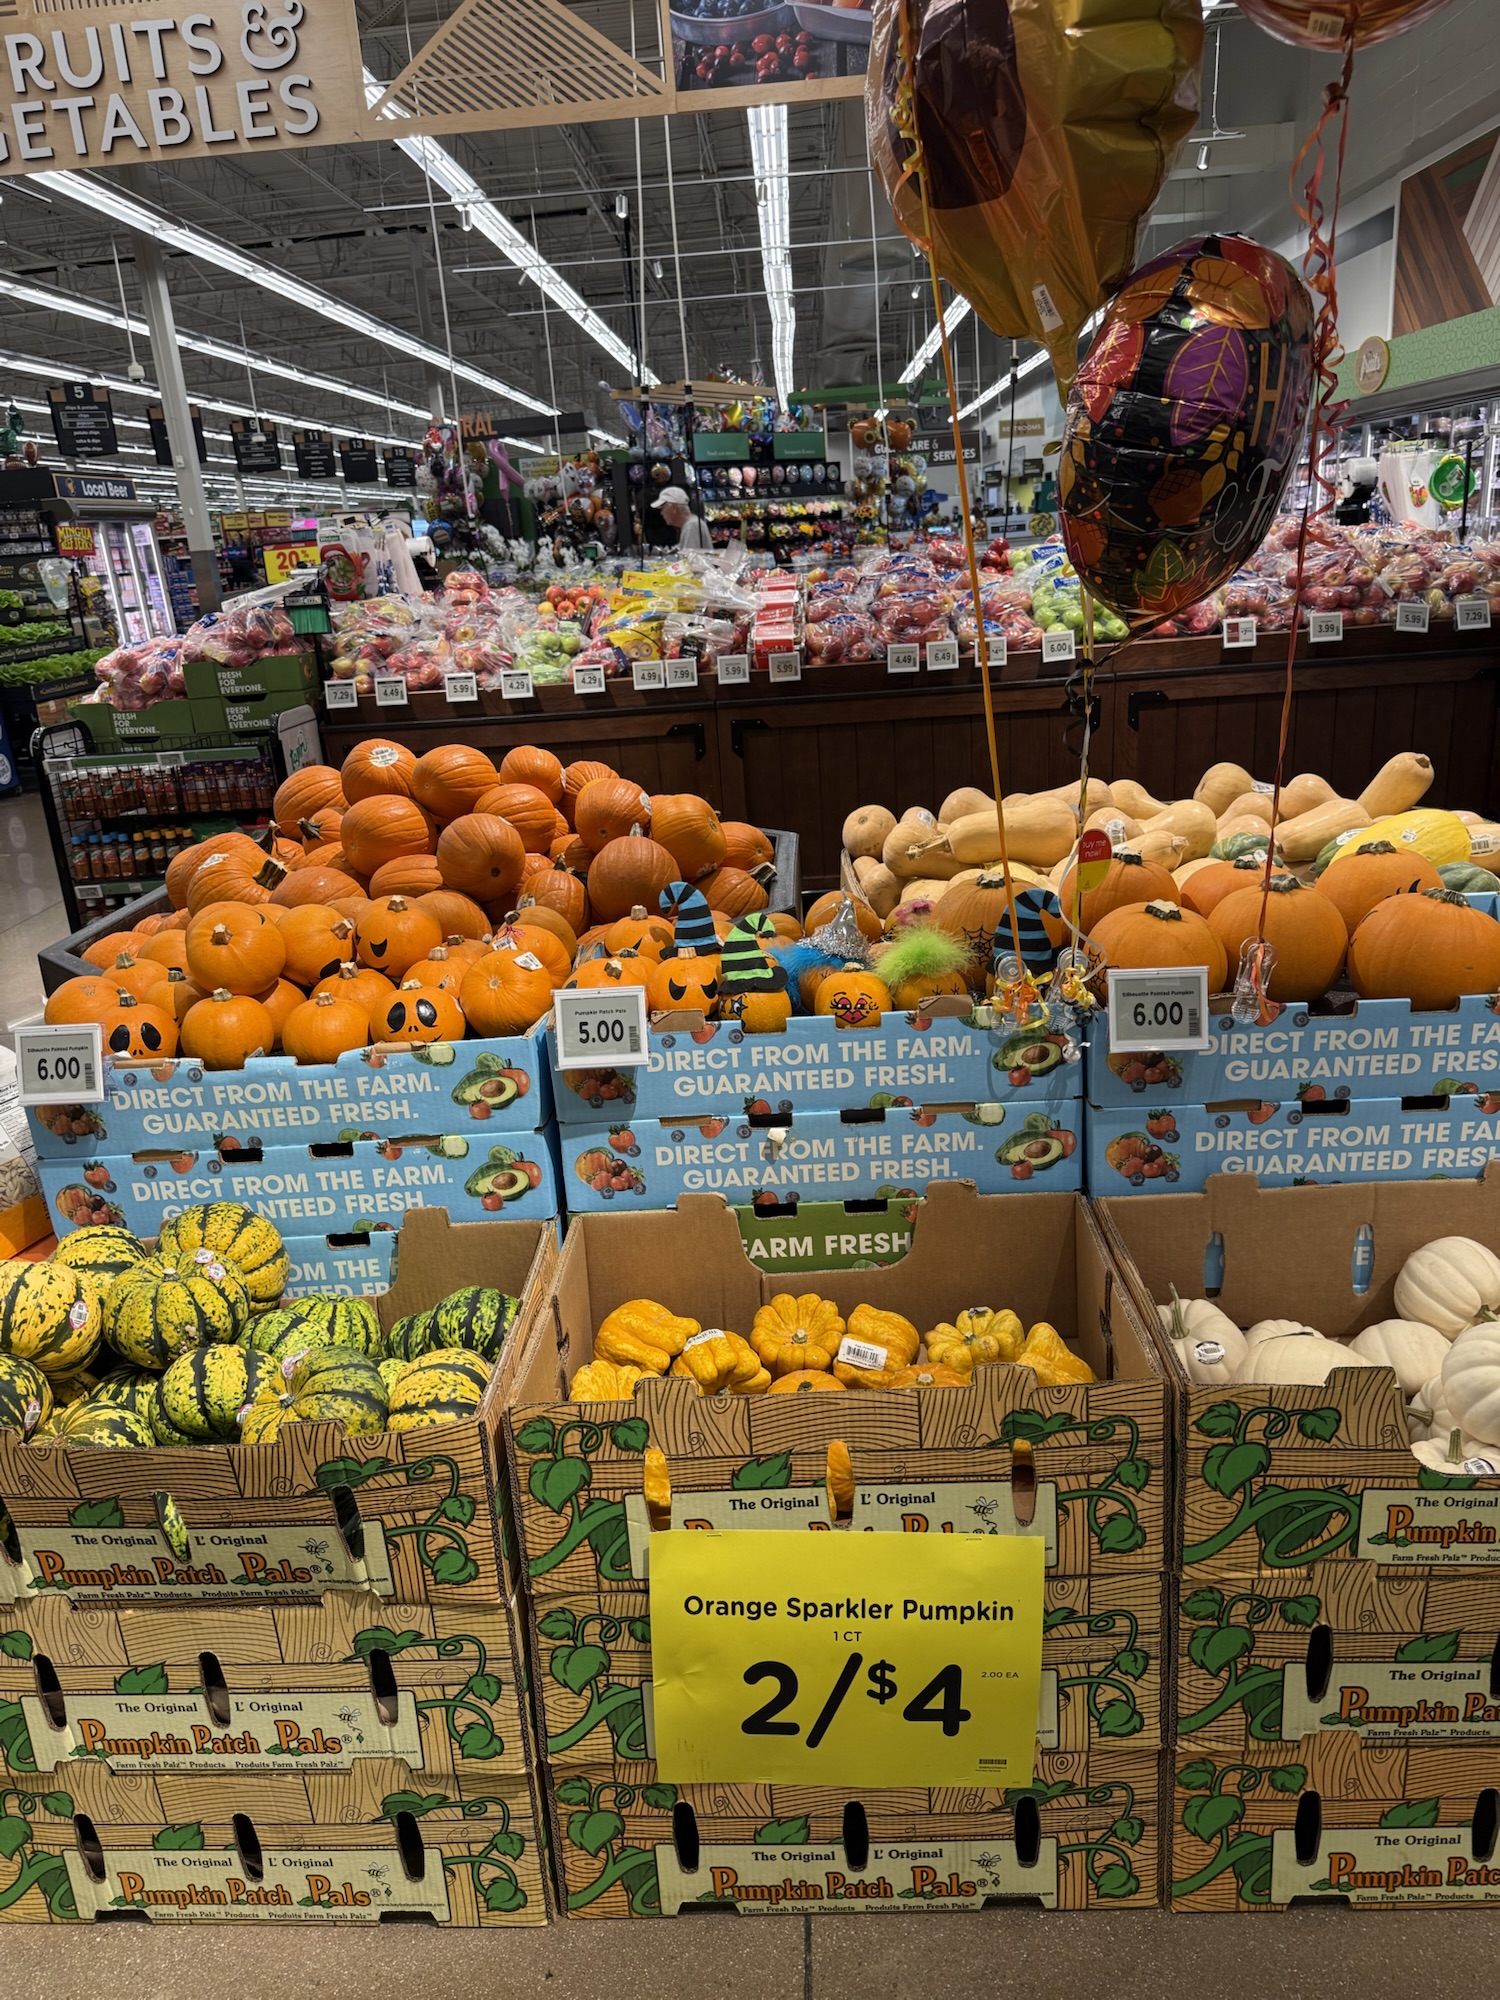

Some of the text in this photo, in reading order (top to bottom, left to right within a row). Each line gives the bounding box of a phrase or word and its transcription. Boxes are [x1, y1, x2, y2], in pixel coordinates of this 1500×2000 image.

[240, 0, 304, 70] &
[73, 386, 85, 399] 5
[1002, 424, 1042, 432] RETROOMS
[307, 431, 319, 441] 11
[351, 439, 363, 450] 13
[932, 439, 939, 449] &
[394, 447, 405, 457] 15
[81, 480, 129, 498] Local Beer
[276, 550, 300, 570] 20
[1404, 614, 1421, 624] 5.99
[1464, 611, 1482, 621] 7.29
[1318, 623, 1335, 634] 3.99
[1050, 642, 1067, 653] 6.00
[895, 653, 912, 664] 4.49
[934, 651, 951, 662] 6.49
[674, 669, 690, 679] 7.99
[725, 666, 741, 676] 5.99
[776, 664, 793, 673] 5.99
[217, 671, 242, 680] FRESH
[581, 675, 597, 685] 4.29
[641, 672, 657, 681] 4.99
[219, 678, 235, 687] FOR
[509, 681, 525, 691] 4.29
[383, 687, 399, 698] 4.49
[453, 684, 470, 695] 5.99
[333, 690, 350, 701] 7.29
[226, 706, 250, 715] FRESH
[112, 712, 137, 722] FRESH
[227, 714, 244, 722] FOR
[114, 720, 130, 728] FOR
[1096, 839, 1106, 847] me
[1133, 1002, 1183, 1026] 6.00
[579, 1019, 624, 1044] 5.00
[1199, 1032, 1304, 1056] DIRECT
[1314, 1027, 1399, 1051] FROM
[1410, 1024, 1462, 1047] THE
[647, 1035, 981, 1072] DIRECT FROM THE FARM.
[37, 1056, 80, 1080] 6.00
[1225, 1054, 1422, 1082] GUARANTEED
[674, 1063, 955, 1097] GUARANTEED FRESH.
[113, 1072, 441, 1111] DIRECT FROM THE FARM.
[143, 1100, 419, 1134] GUARANTEED FRESH.
[1195, 1129, 1298, 1152] DIRECT
[1307, 1125, 1390, 1147] FROM
[1401, 1121, 1451, 1144] THE
[656, 1131, 984, 1167] DIRECT FROM THE FARM.
[1221, 1150, 1412, 1176] GUARANTEED
[683, 1157, 959, 1189] GUARANTEED FRESH.
[132, 1165, 454, 1202] DIRECT FROM THE FARM.
[825, 1232, 912, 1256] FRESH
[334, 1258, 381, 1280] THE
[729, 1498, 757, 1510] The
[760, 1495, 819, 1510] Original
[876, 1491, 936, 1506] Original
[1415, 1496, 1498, 1508] The Original
[1387, 1504, 1496, 1549] Pumpkin
[72, 1535, 99, 1545] The
[102, 1535, 157, 1547] Original
[210, 1534, 268, 1547] Original
[1392, 1554, 1414, 1562] Farm
[1416, 1554, 1440, 1562] Fresh
[34, 1551, 153, 1590] Pumpkin
[153, 1557, 227, 1586] Patch
[101, 1591, 125, 1599] Fresh
[153, 1591, 192, 1599] Products
[201, 1590, 239, 1599] Produits
[240, 1590, 263, 1598] Farm
[265, 1589, 289, 1597] Fresh
[683, 1595, 1014, 1624] Orange Sparkler Pumpkin
[833, 1631, 862, 1642] 1 CT
[1389, 1670, 1481, 1682] The Original
[1340, 1686, 1459, 1729] Pumpkin
[78, 1719, 193, 1759] Pumpkin
[191, 1724, 260, 1755] Patch
[710, 1867, 823, 1904] Pumpkin
[825, 1872, 893, 1900] Patch
